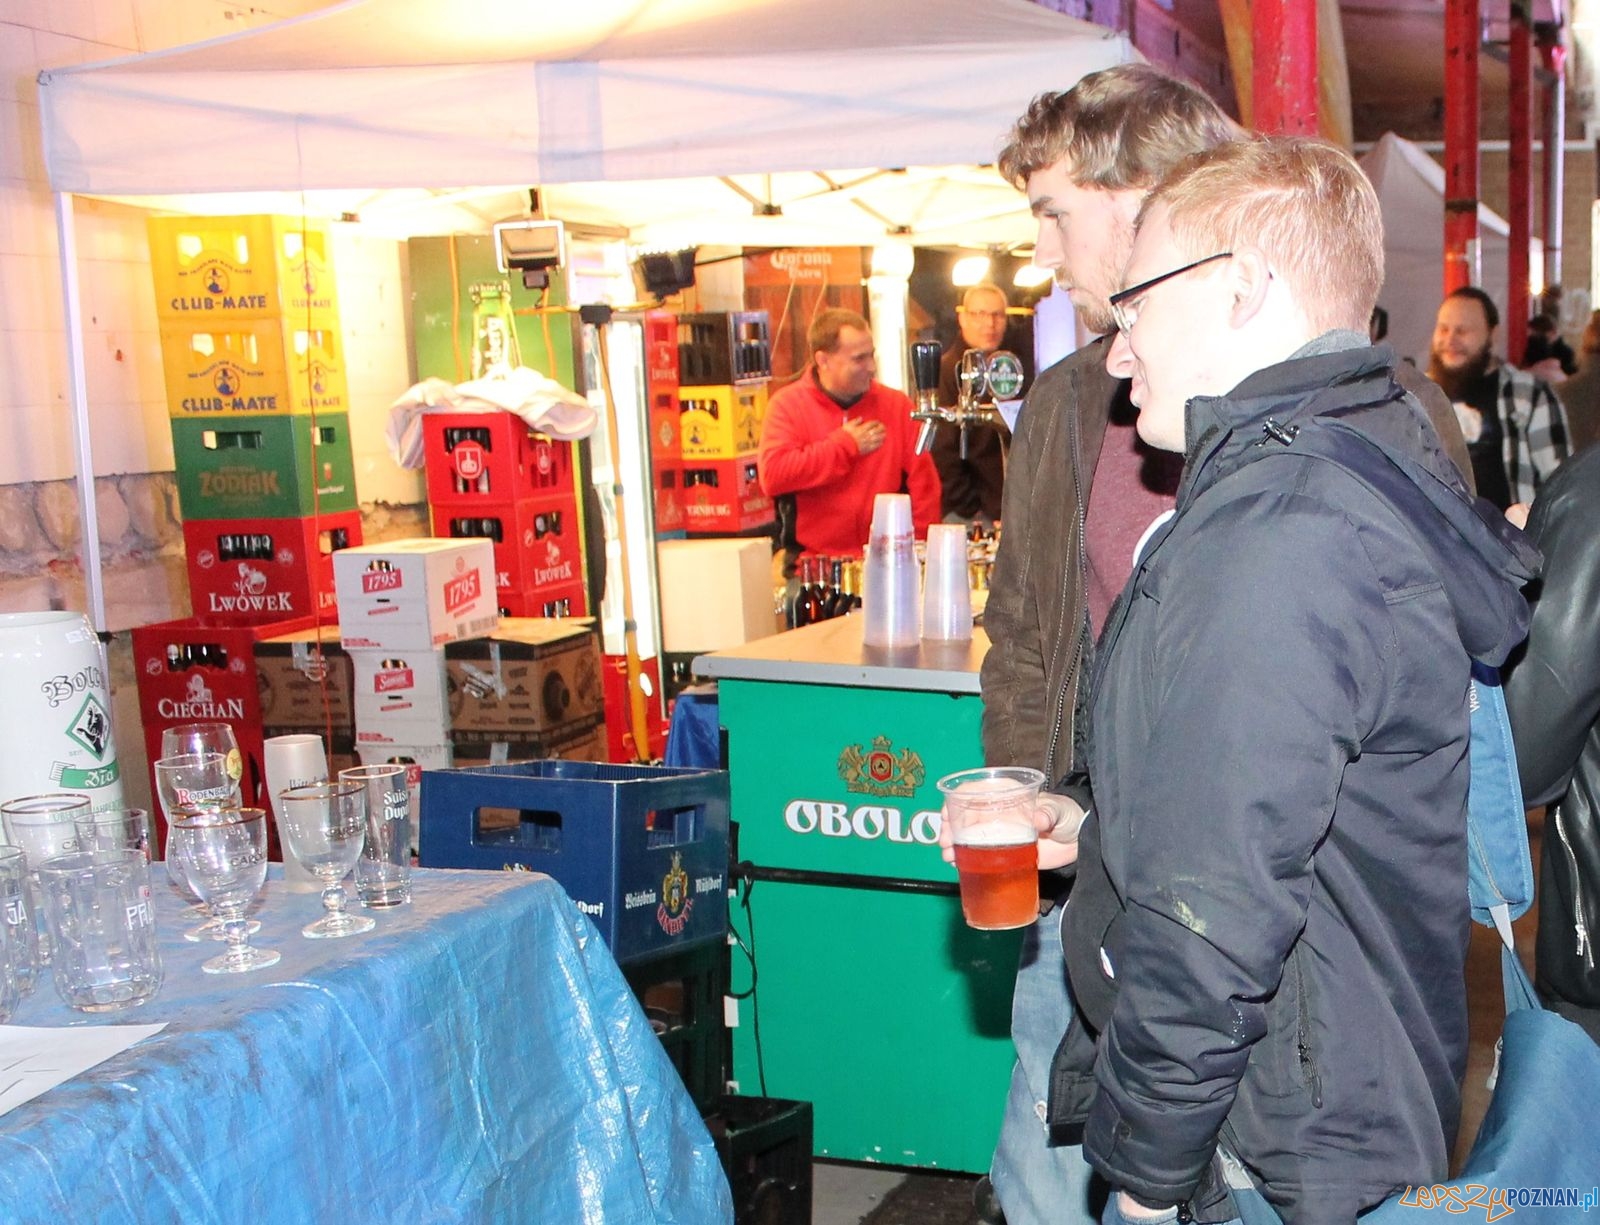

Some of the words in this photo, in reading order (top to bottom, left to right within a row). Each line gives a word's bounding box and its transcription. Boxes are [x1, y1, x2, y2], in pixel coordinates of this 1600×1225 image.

[171, 295, 267, 311] CLUB-MATE
[182, 396, 278, 412] CLUB-MATE
[367, 573, 396, 592] 1795
[448, 576, 476, 605] 1795
[157, 698, 245, 720] CIECHAN
